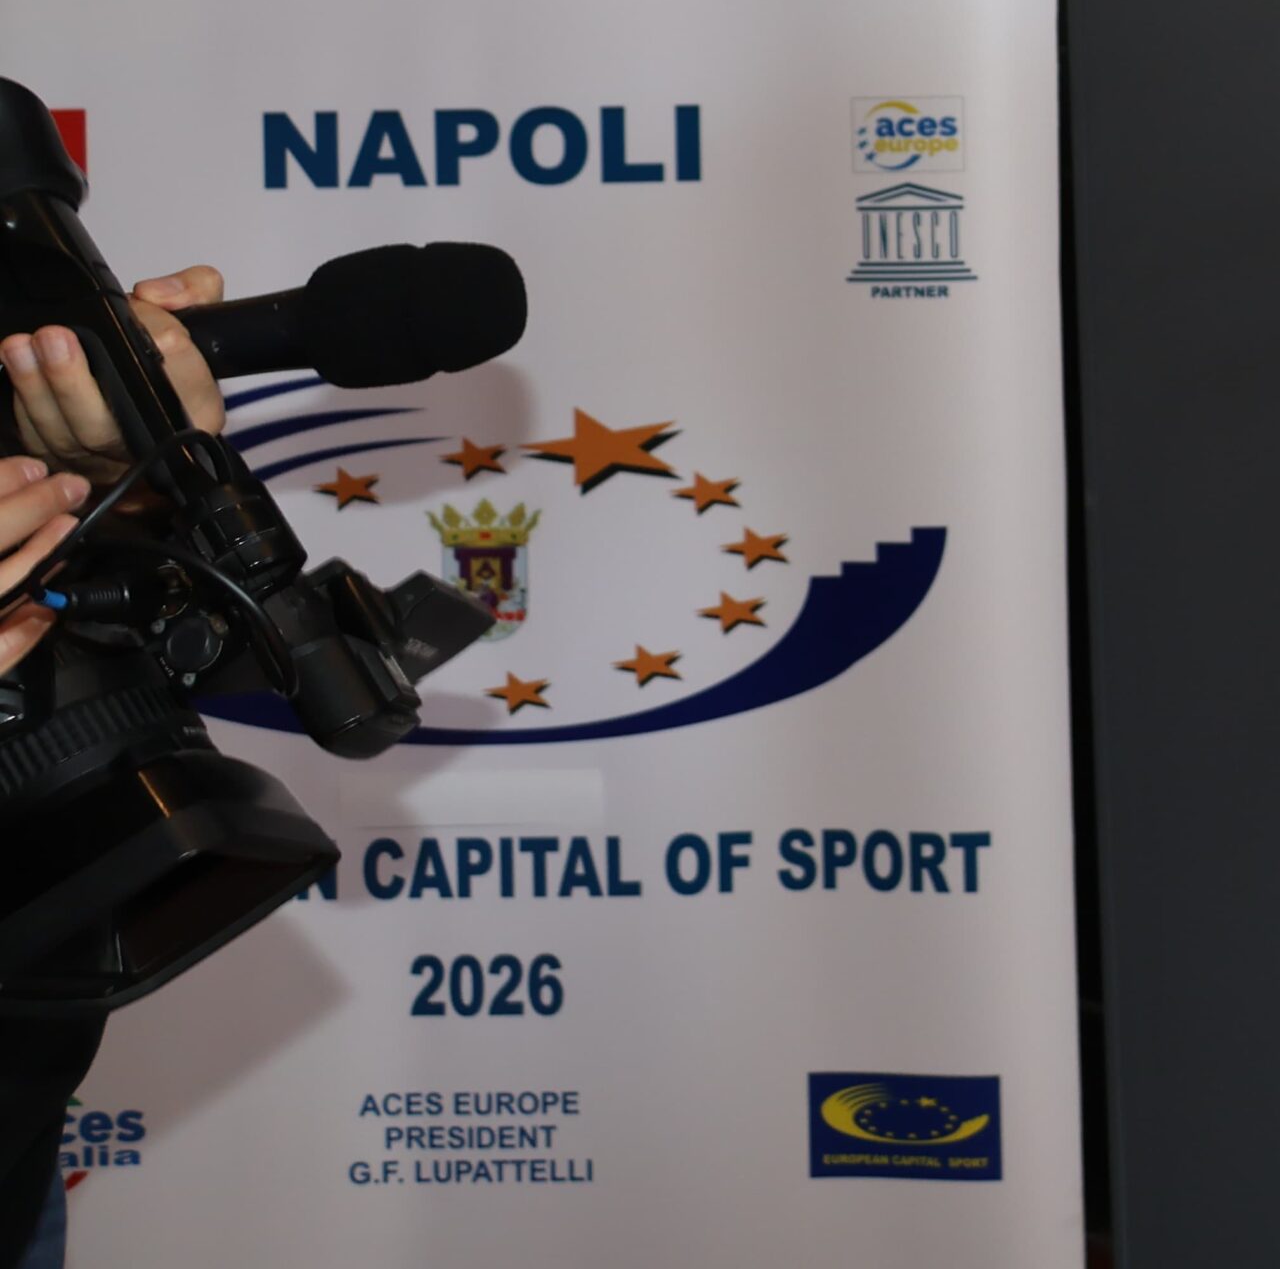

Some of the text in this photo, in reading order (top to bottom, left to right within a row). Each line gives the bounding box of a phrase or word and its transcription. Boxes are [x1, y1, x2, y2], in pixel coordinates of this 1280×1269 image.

[875, 116, 958, 137] aces
[263, 105, 702, 189] NAPOLI
[874, 137, 959, 155] europe
[863, 211, 958, 261] UNESCO
[871, 286, 949, 299] PARTNER
[362, 835, 642, 900] CAPITAL
[665, 831, 752, 895] OF
[778, 829, 991, 893] SPORT
[410, 954, 564, 1018] 2026
[360, 1092, 580, 1116] ACES EUROPE
[385, 1125, 557, 1150] PRESIDENT
[59, 1145, 141, 1167] alia
[823, 1154, 989, 1169] EUROPEAN CAPITAL SPORT
[349, 1159, 594, 1185] G.F. LUPATTELLI
